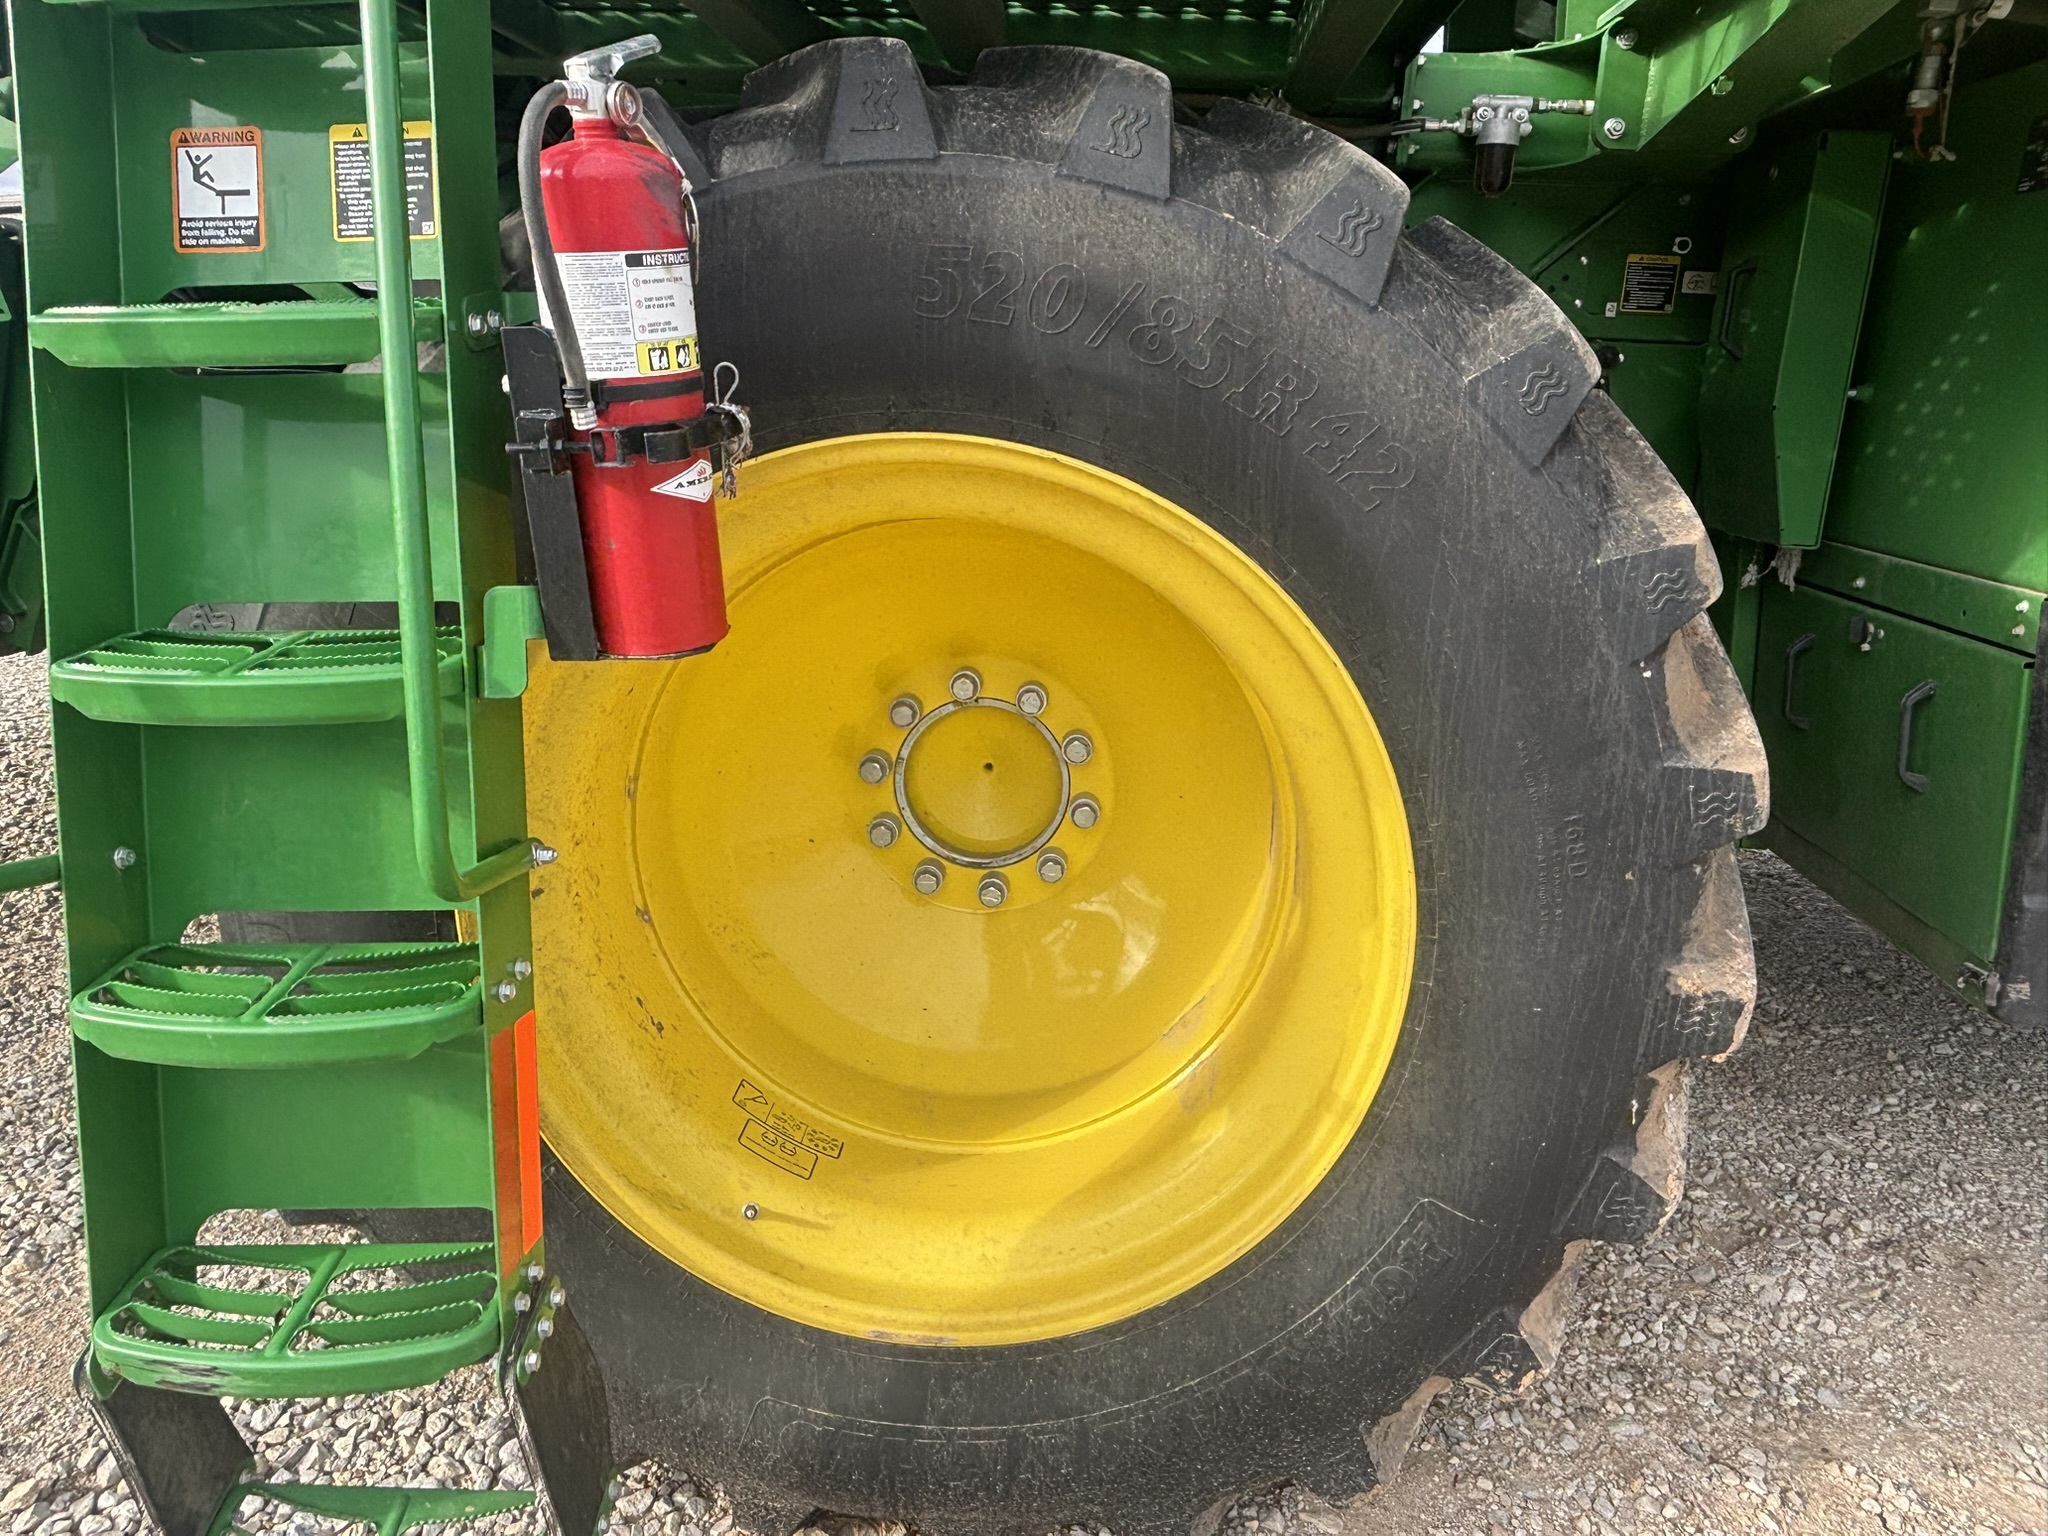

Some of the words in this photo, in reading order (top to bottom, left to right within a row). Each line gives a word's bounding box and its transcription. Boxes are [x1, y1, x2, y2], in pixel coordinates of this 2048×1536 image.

[190, 130, 255, 143] WARNING
[181, 219, 204, 228] Avoid
[205, 219, 234, 228] serious
[234, 218, 258, 228] injury
[181, 228, 201, 237] from
[201, 227, 227, 238] falling.
[227, 227, 240, 236] Do
[240, 227, 255, 236] not
[181, 237, 197, 246] ride
[198, 238, 210, 246] on
[210, 236, 246, 246] machine.
